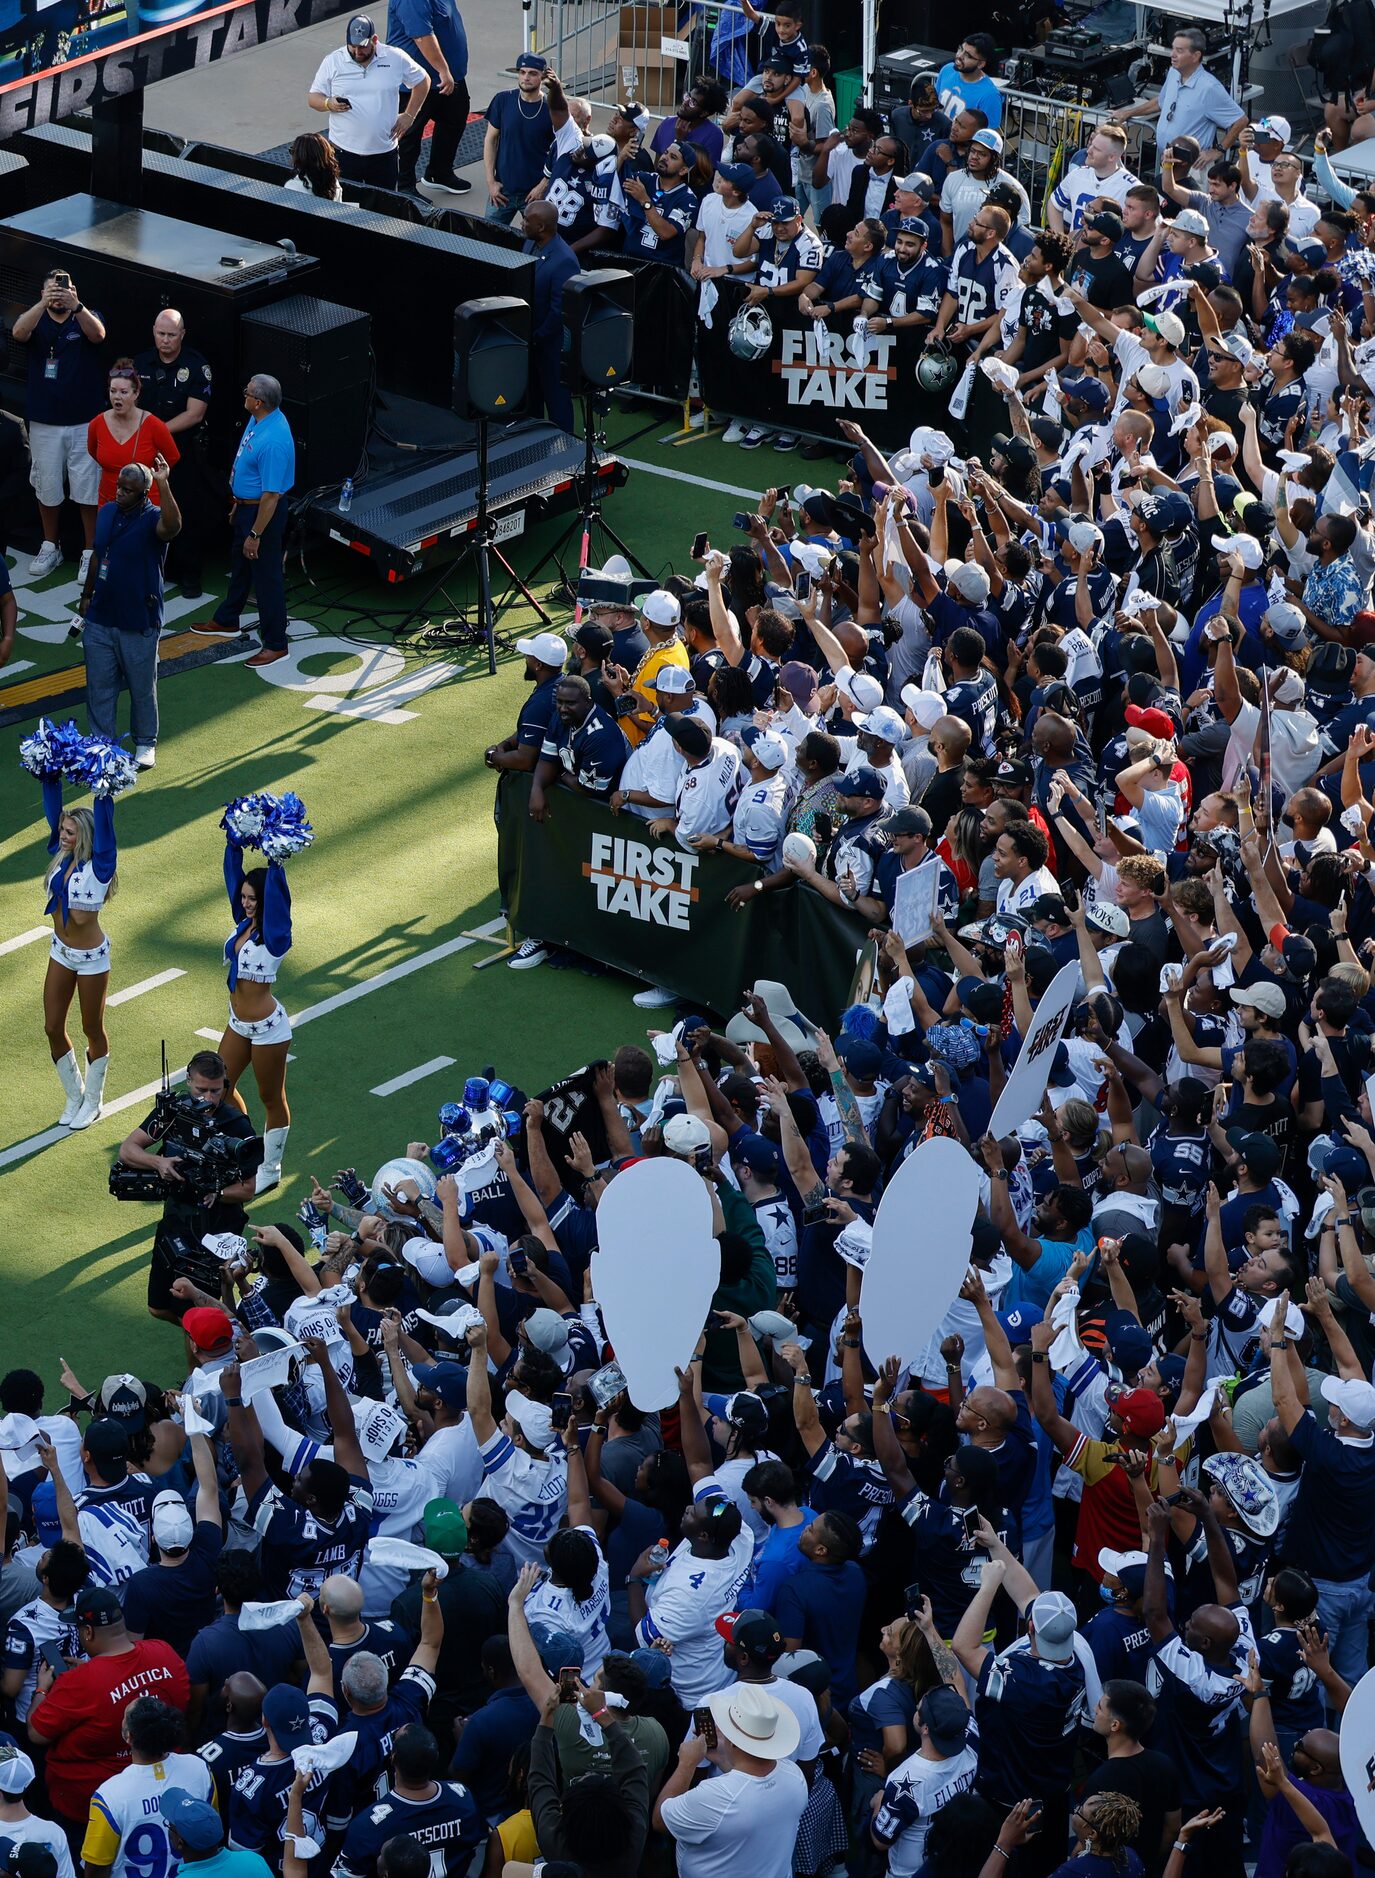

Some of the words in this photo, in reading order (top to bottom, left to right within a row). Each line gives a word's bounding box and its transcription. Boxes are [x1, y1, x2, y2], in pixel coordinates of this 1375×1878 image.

[545, 178, 584, 228] 88
[759, 260, 788, 288] 21
[958, 276, 989, 324] 82
[781, 329, 896, 371] FIRST
[781, 368, 888, 410] TAKE
[586, 718, 604, 735] 11
[718, 755, 736, 789] MILLER
[591, 833, 700, 891] FIRST
[590, 872, 691, 931] TAKE
[1019, 885, 1038, 906] 21
[470, 1186, 505, 1203] BALL
[315, 1543, 346, 1565] LAMB
[688, 1571, 706, 1591] 4
[547, 1595, 563, 1612] 11
[579, 1580, 609, 1621] PARSONS
[109, 1667, 173, 1704] NAUTICA
[370, 1802, 395, 1826] 4
[874, 1805, 899, 1841] 21
